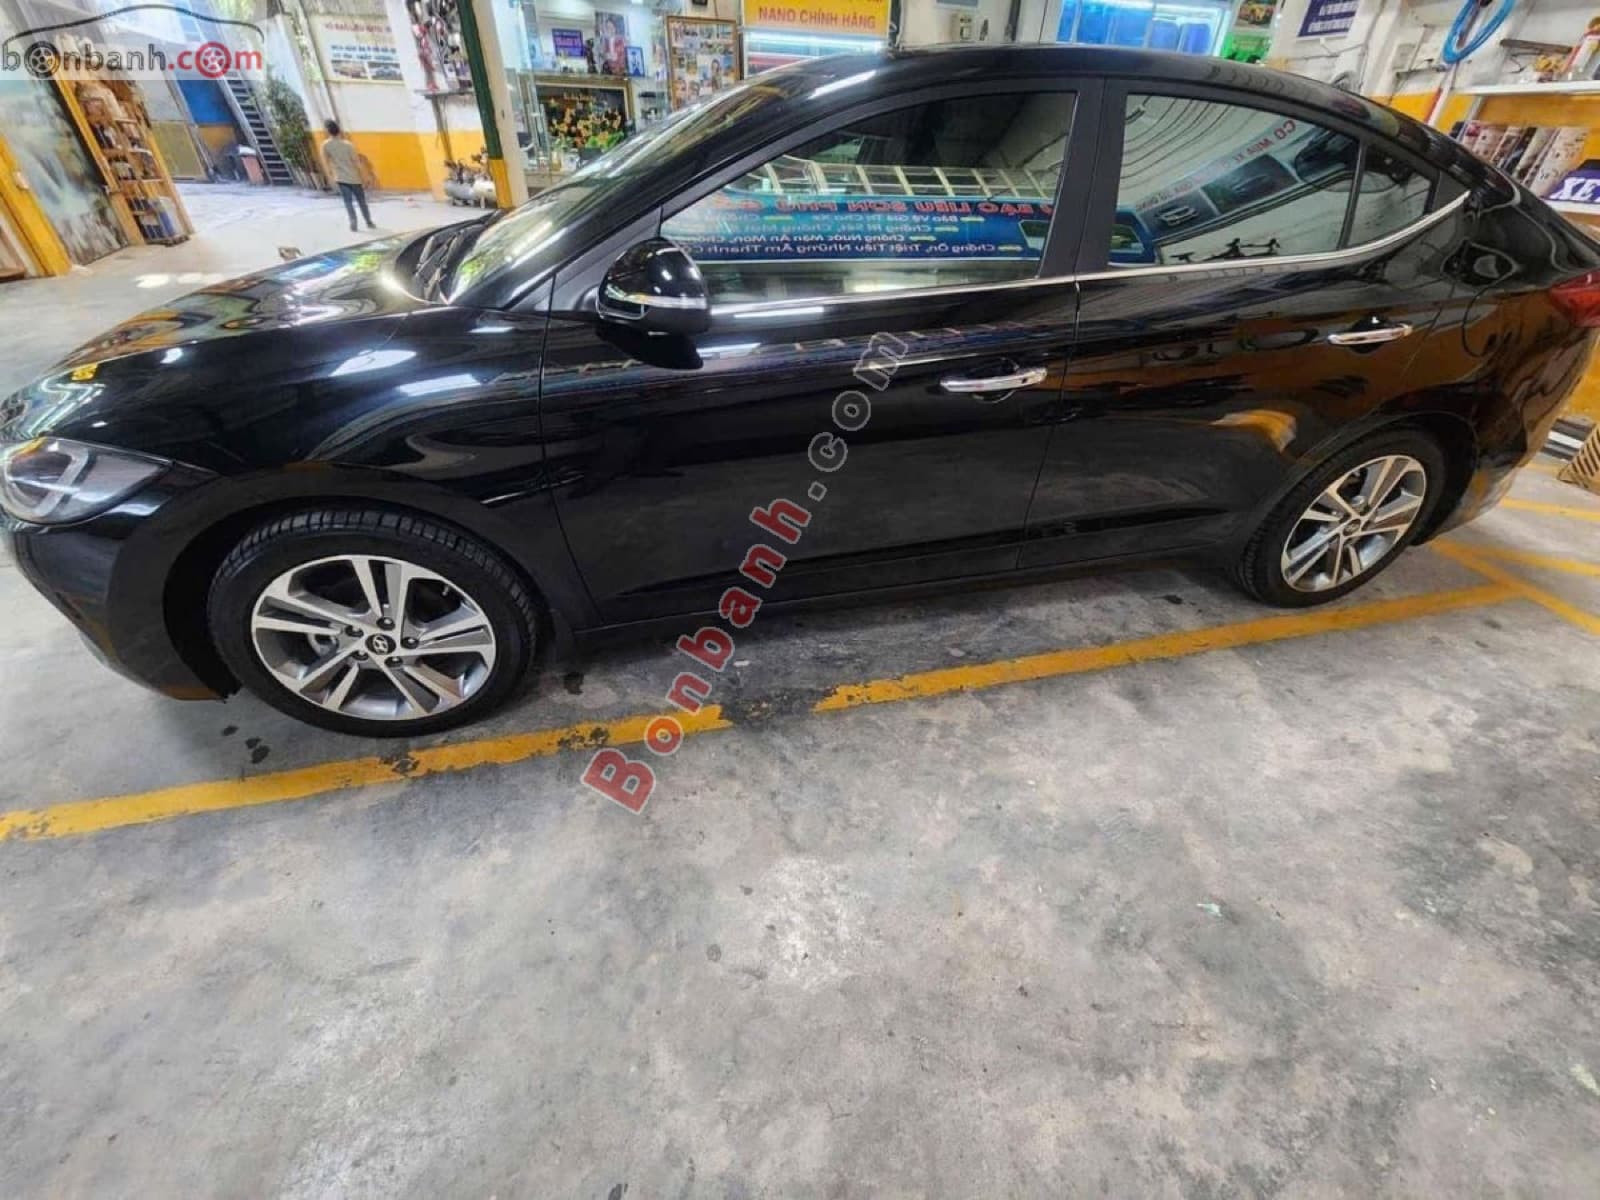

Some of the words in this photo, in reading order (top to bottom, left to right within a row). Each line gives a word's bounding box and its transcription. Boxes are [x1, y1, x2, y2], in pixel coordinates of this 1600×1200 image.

[759, 7, 797, 22] NANO
[799, 8, 838, 25] CHÍNH
[842, 12, 876, 29] HÀNG
